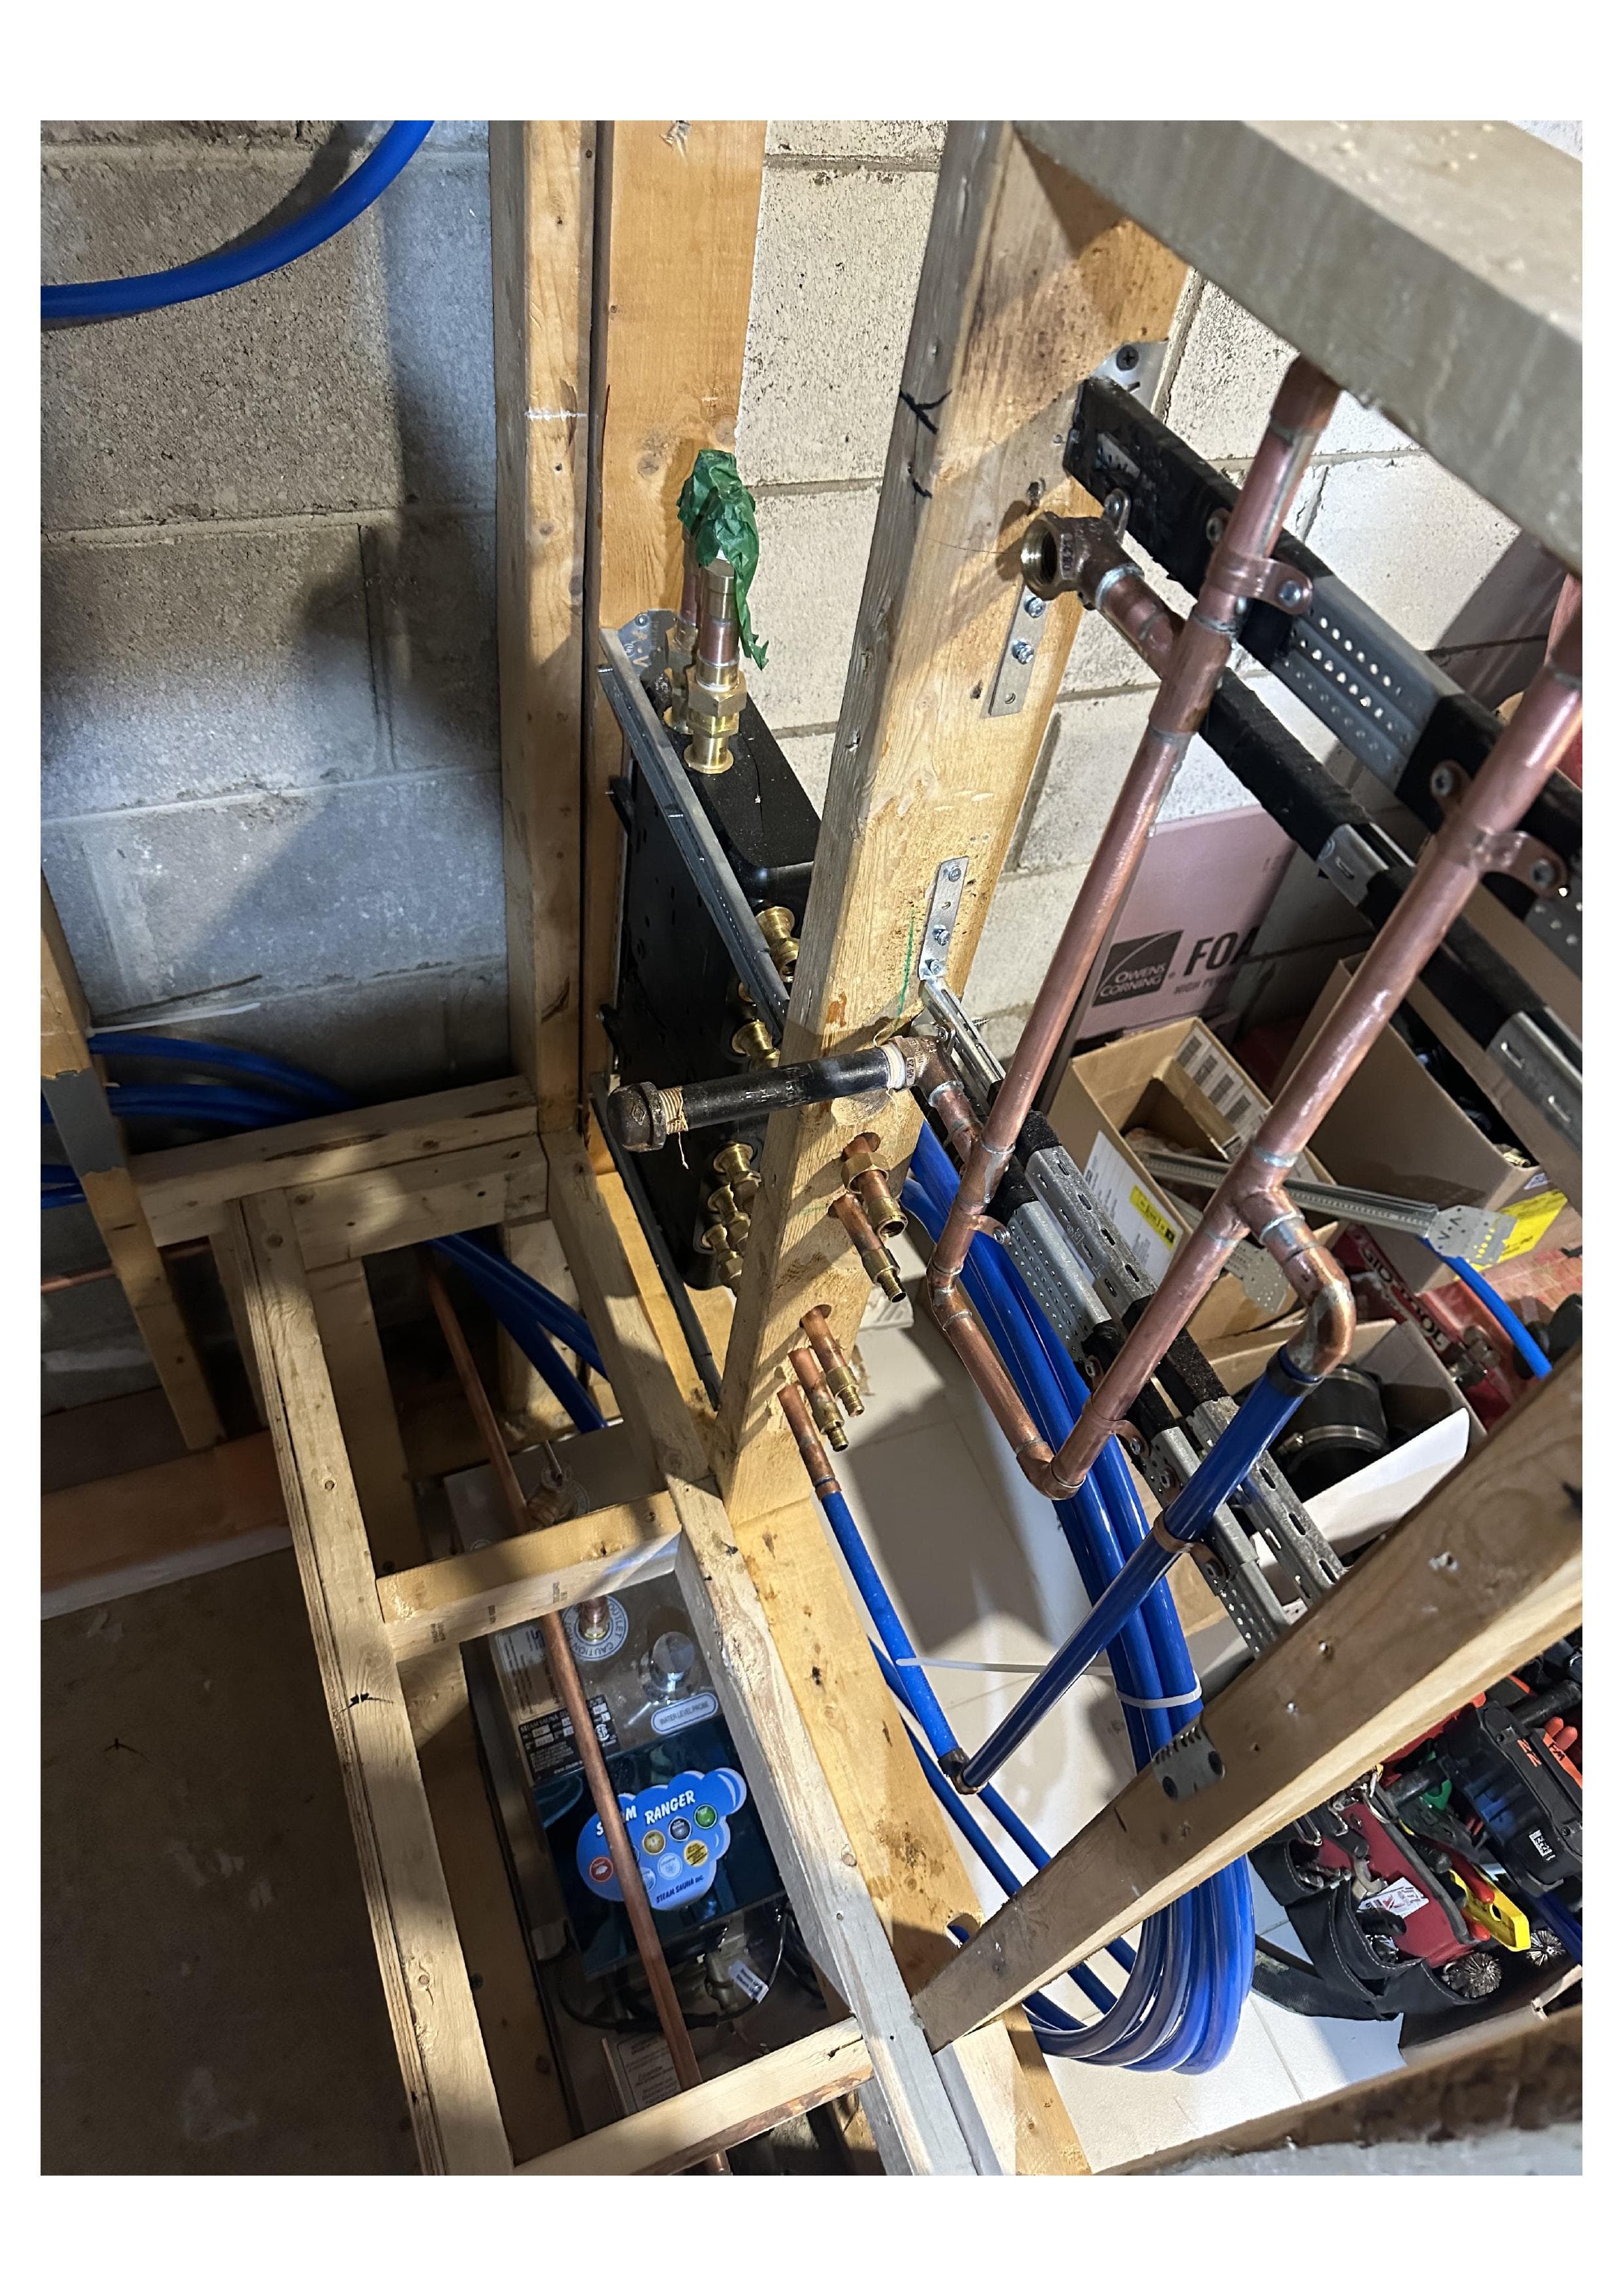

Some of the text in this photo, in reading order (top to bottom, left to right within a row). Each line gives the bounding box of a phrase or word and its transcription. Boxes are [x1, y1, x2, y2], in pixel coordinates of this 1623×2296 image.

[1115, 963, 1166, 983] OWENS
[1099, 976, 1162, 997] CORNING
[575, 1642, 614, 1656] CAUTION
[659, 1712, 677, 1725] WATER
[677, 1706, 692, 1718] LEVEL
[645, 1790, 696, 1825] RANGER
[656, 1887, 675, 1904] STEAM
[675, 1877, 694, 1894] SAUNA
